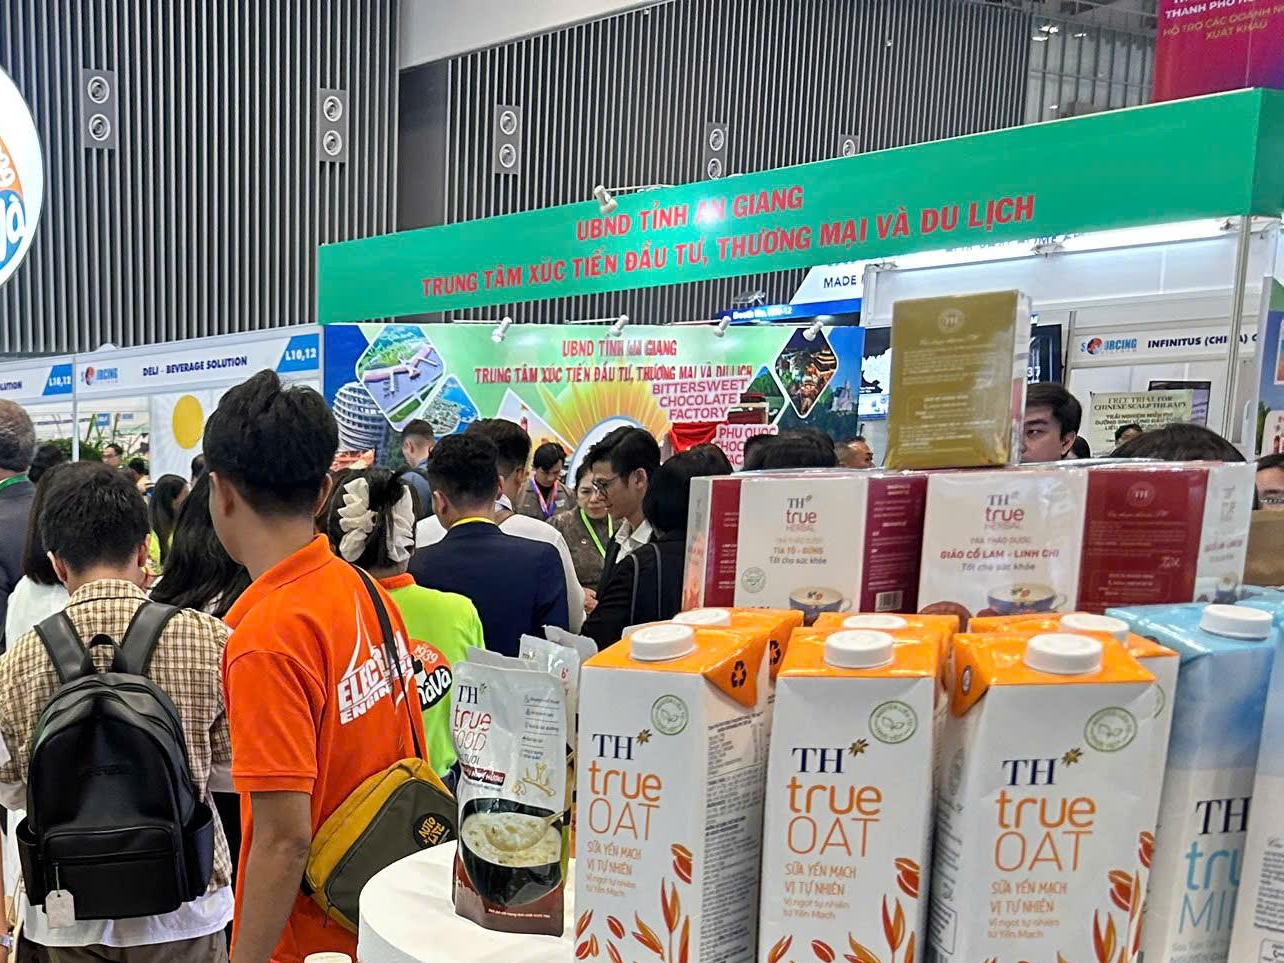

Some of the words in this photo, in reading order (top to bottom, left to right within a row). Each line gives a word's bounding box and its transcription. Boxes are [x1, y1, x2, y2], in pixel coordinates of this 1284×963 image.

[576, 214, 631, 242] UBND
[640, 201, 687, 231] TỈNH
[732, 185, 804, 219] GIANG
[422, 272, 478, 298] TRUNG
[484, 264, 522, 290] TÂM
[528, 259, 566, 285] XÚC
[573, 247, 618, 280] TIẾN
[624, 241, 667, 273] ĐẦU
[717, 225, 813, 262] THƯƠNG
[819, 217, 867, 249] MẠI
[876, 206, 910, 241] VÀ
[920, 204, 960, 236] DU
[968, 194, 1036, 229] LỊCH
[823, 275, 857, 289] MADE
[562, 339, 595, 357] UBND
[1147, 336, 1202, 349] INFINITUS
[1204, 333, 1249, 348] (CHIA)
[142, 365, 160, 378] DELI
[166, 360, 205, 374] BEVERAGE
[206, 355, 248, 371] SOLUTION
[284, 347, 318, 362] L10,12
[474, 367, 512, 384] TRUNG
[513, 364, 538, 384] TÂM
[652, 379, 748, 395] BITTERSWEET
[659, 393, 737, 407] CHOCOLATE
[668, 407, 728, 420] FACTORY
[719, 426, 743, 438] PHU
[786, 509, 817, 524] true
[787, 497, 805, 509] TH
[984, 507, 1025, 522] true
[982, 549, 1005, 560] LAM
[1013, 549, 1040, 560] LINH
[1041, 547, 1060, 559] CHI
[457, 684, 479, 704] TH
[453, 704, 492, 732] true
[592, 733, 636, 761] TH
[792, 747, 846, 774] TH
[588, 760, 662, 802] true
[1002, 757, 1058, 787] TH
[786, 776, 883, 817] true
[995, 789, 1096, 830] true
[588, 798, 661, 841] OAT
[1196, 796, 1252, 835] TH
[787, 816, 880, 857] OAT
[994, 830, 1095, 873] OAT
